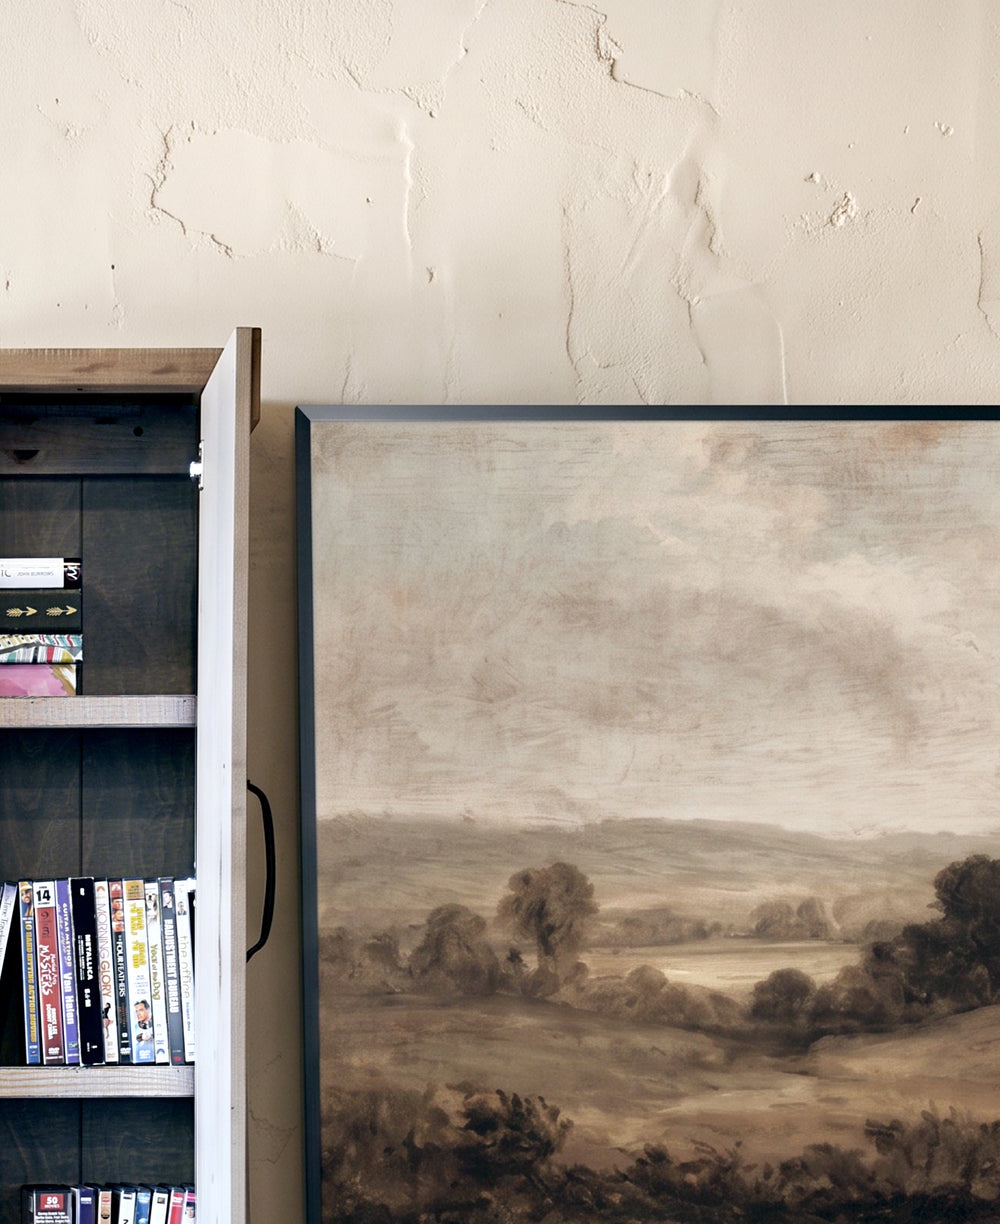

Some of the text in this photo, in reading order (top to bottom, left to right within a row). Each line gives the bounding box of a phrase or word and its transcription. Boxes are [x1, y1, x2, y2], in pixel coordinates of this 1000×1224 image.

[2, 901, 12, 917] Time
[36, 890, 51, 901] 14
[25, 921, 32, 930] 10
[62, 903, 70, 932] GUITAR
[85, 934, 94, 980] METALLICA
[97, 904, 112, 998] MORNING GLORY
[116, 942, 124, 963] FOUR
[150, 944, 159, 963] Year
[163, 924, 177, 979] ADJUSTMENT
[179, 935, 189, 958] the
[38, 944, 54, 996] MASTERS
[117, 963, 126, 998] FEATHERS
[181, 962, 192, 999] office
[63, 972, 76, 1025] Van Halen
[151, 981, 161, 1001] Dog
[167, 979, 180, 1014] BUREAU
[46, 1196, 58, 1205] 50
